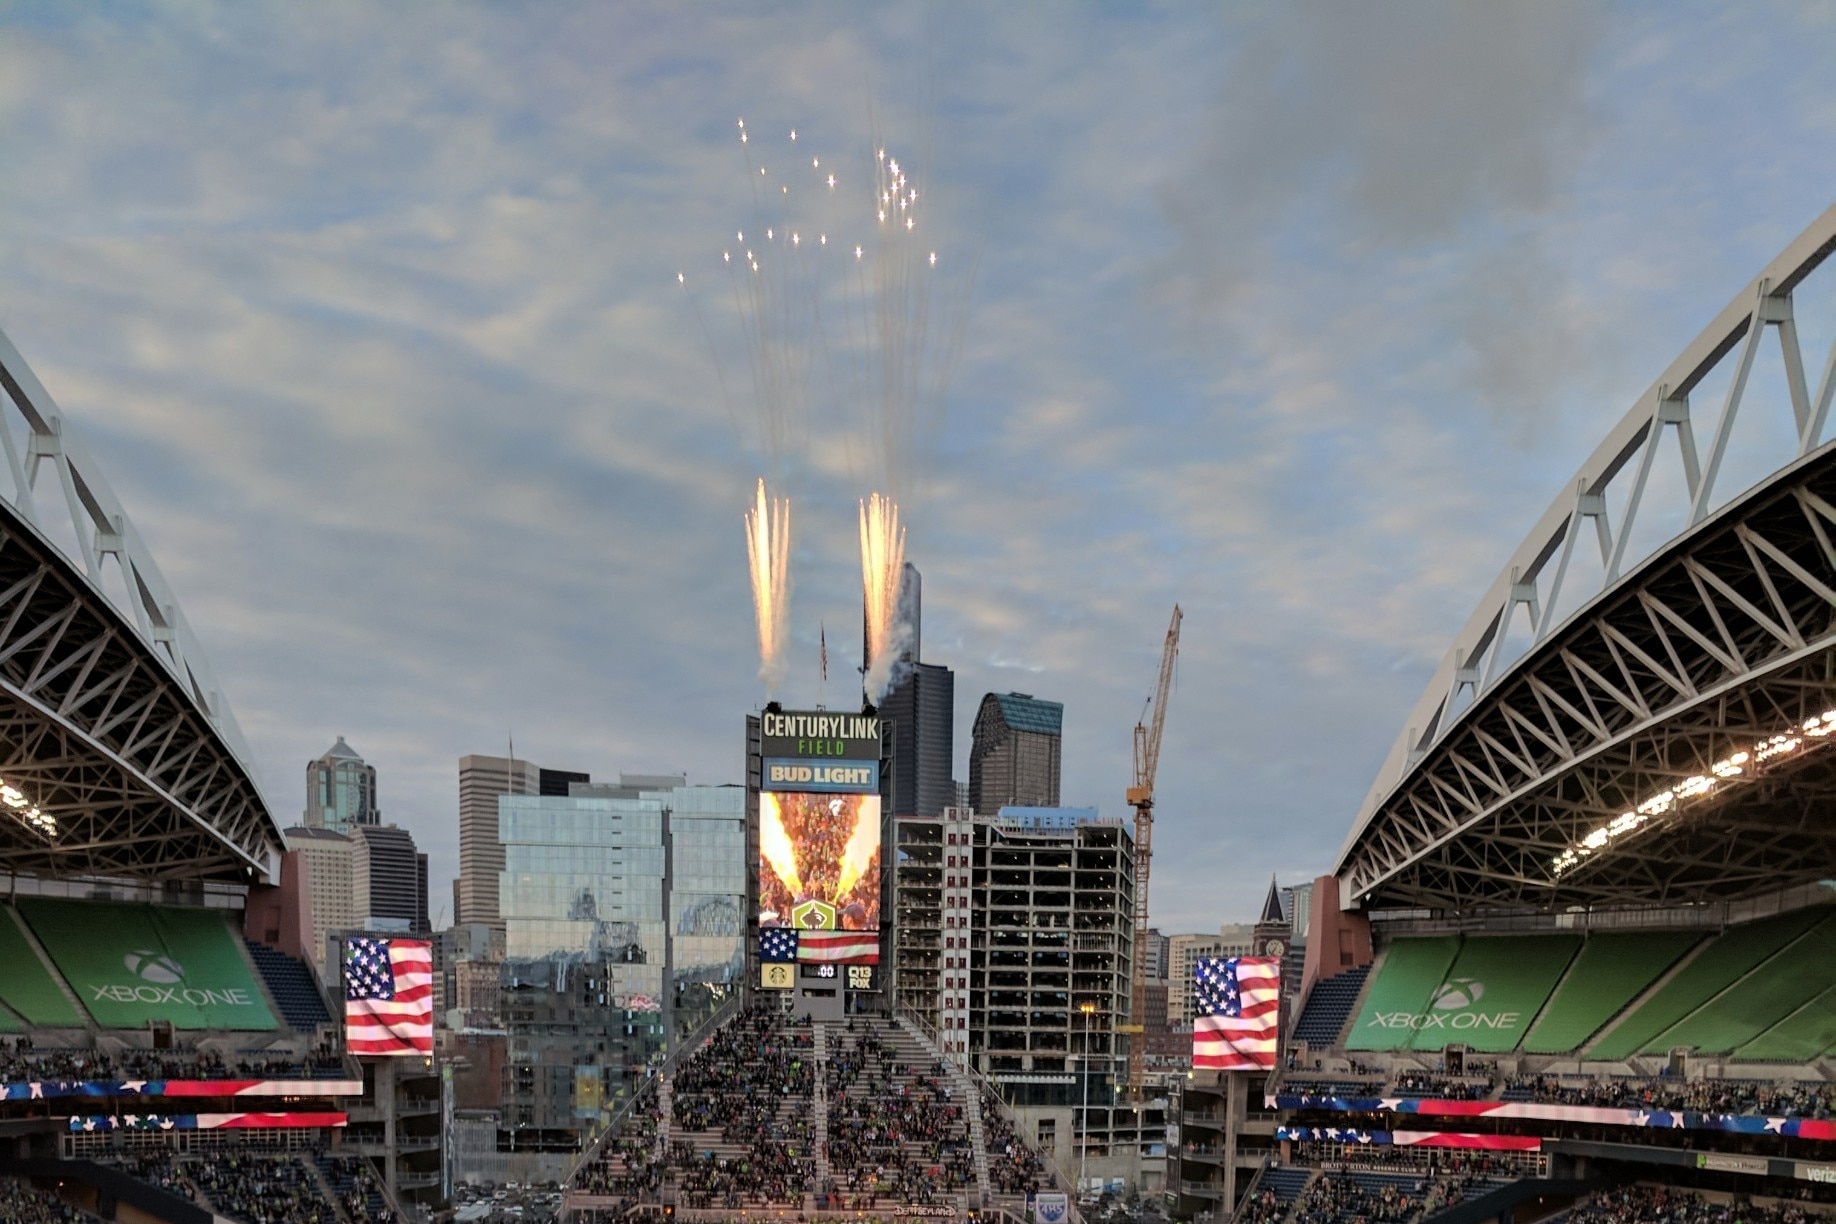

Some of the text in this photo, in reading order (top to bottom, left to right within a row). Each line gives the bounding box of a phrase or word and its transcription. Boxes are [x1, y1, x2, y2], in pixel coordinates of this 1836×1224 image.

[764, 713, 878, 739] CENTURYLINK
[798, 740, 845, 755] FIELD
[771, 766, 870, 784] BUD LIGHT
[848, 966, 872, 979] Q13
[849, 978, 870, 989] FOX
[88, 984, 253, 1006] XBOX ONE
[1367, 1012, 1521, 1029] XBOX ONE
